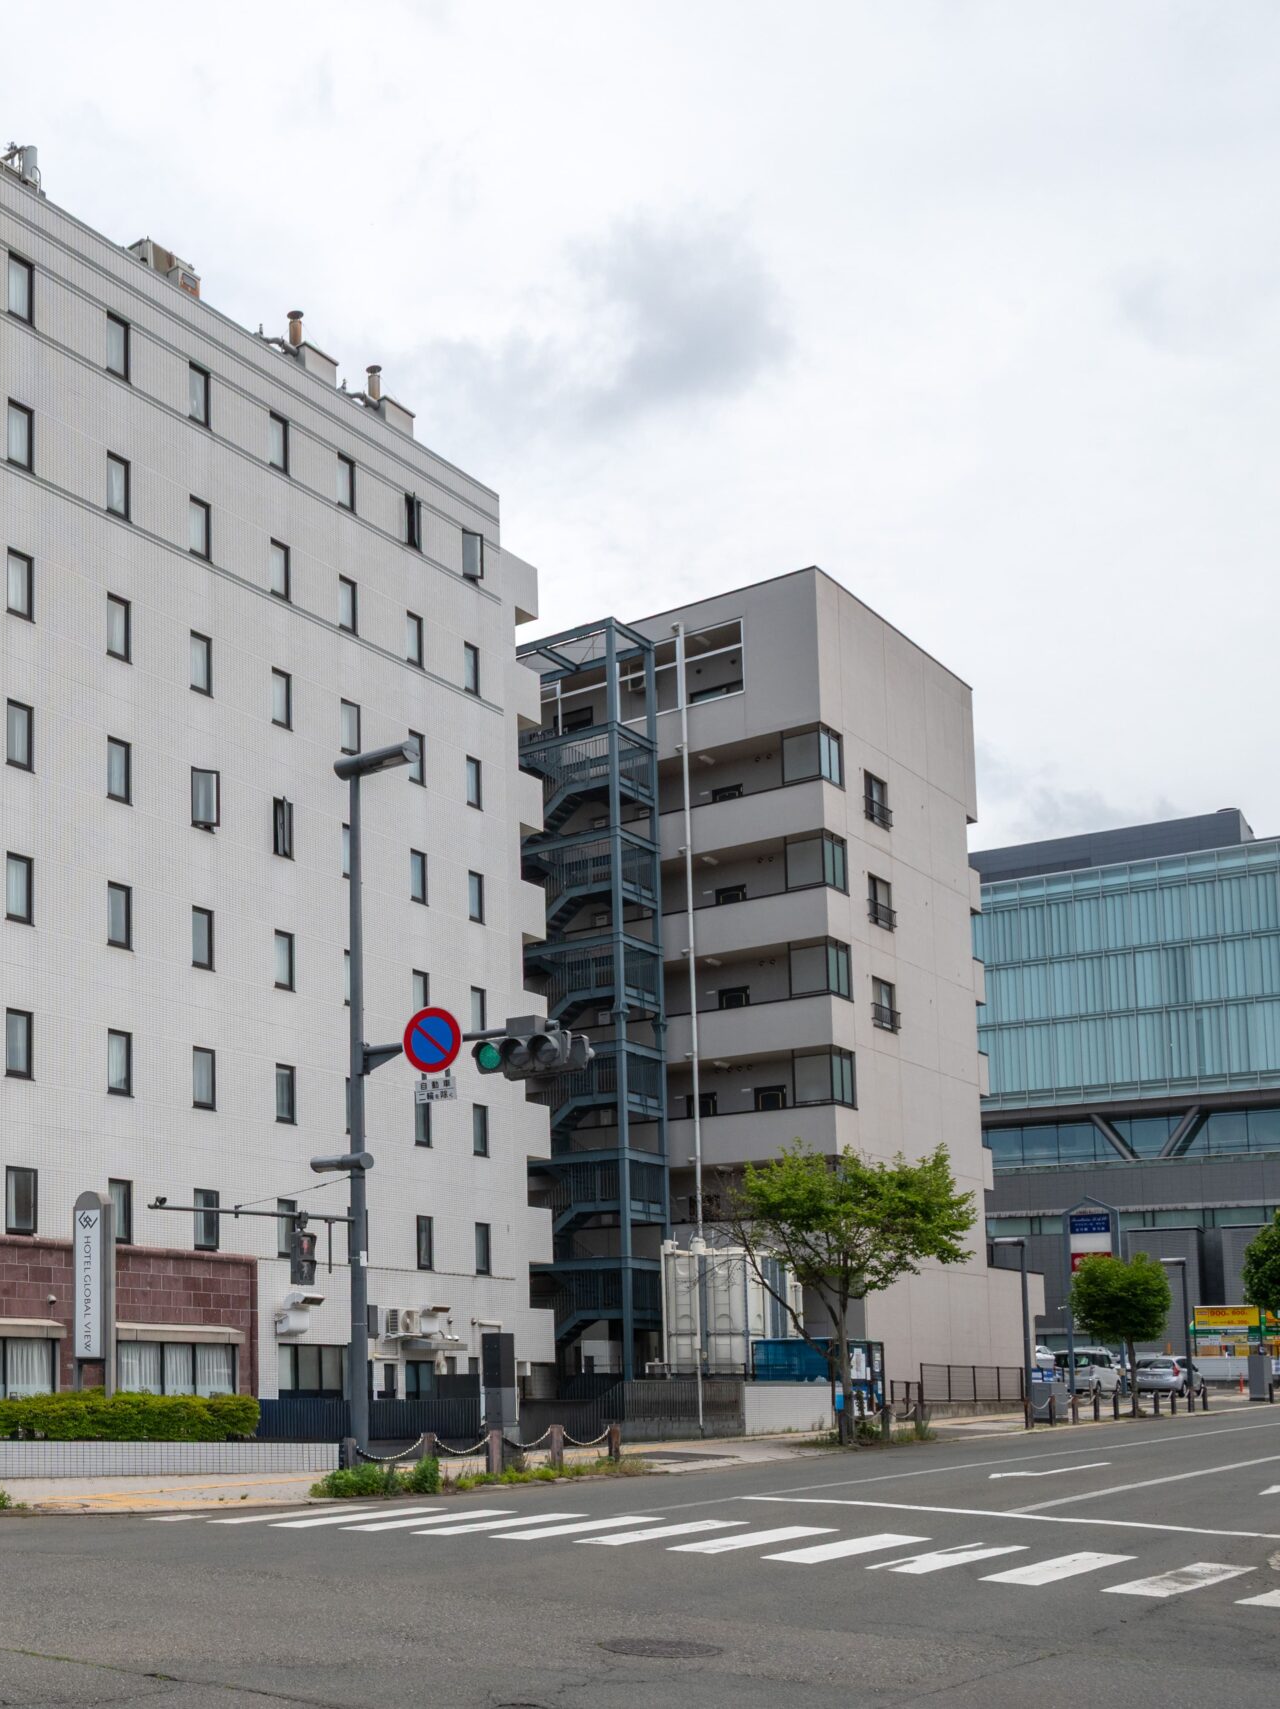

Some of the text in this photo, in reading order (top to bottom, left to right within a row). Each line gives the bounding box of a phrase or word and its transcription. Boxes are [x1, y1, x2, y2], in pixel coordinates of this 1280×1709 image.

[420, 1079, 450, 1090] 自動車
[83, 1235, 92, 1352] HOTEL GLOBAL VIEW
